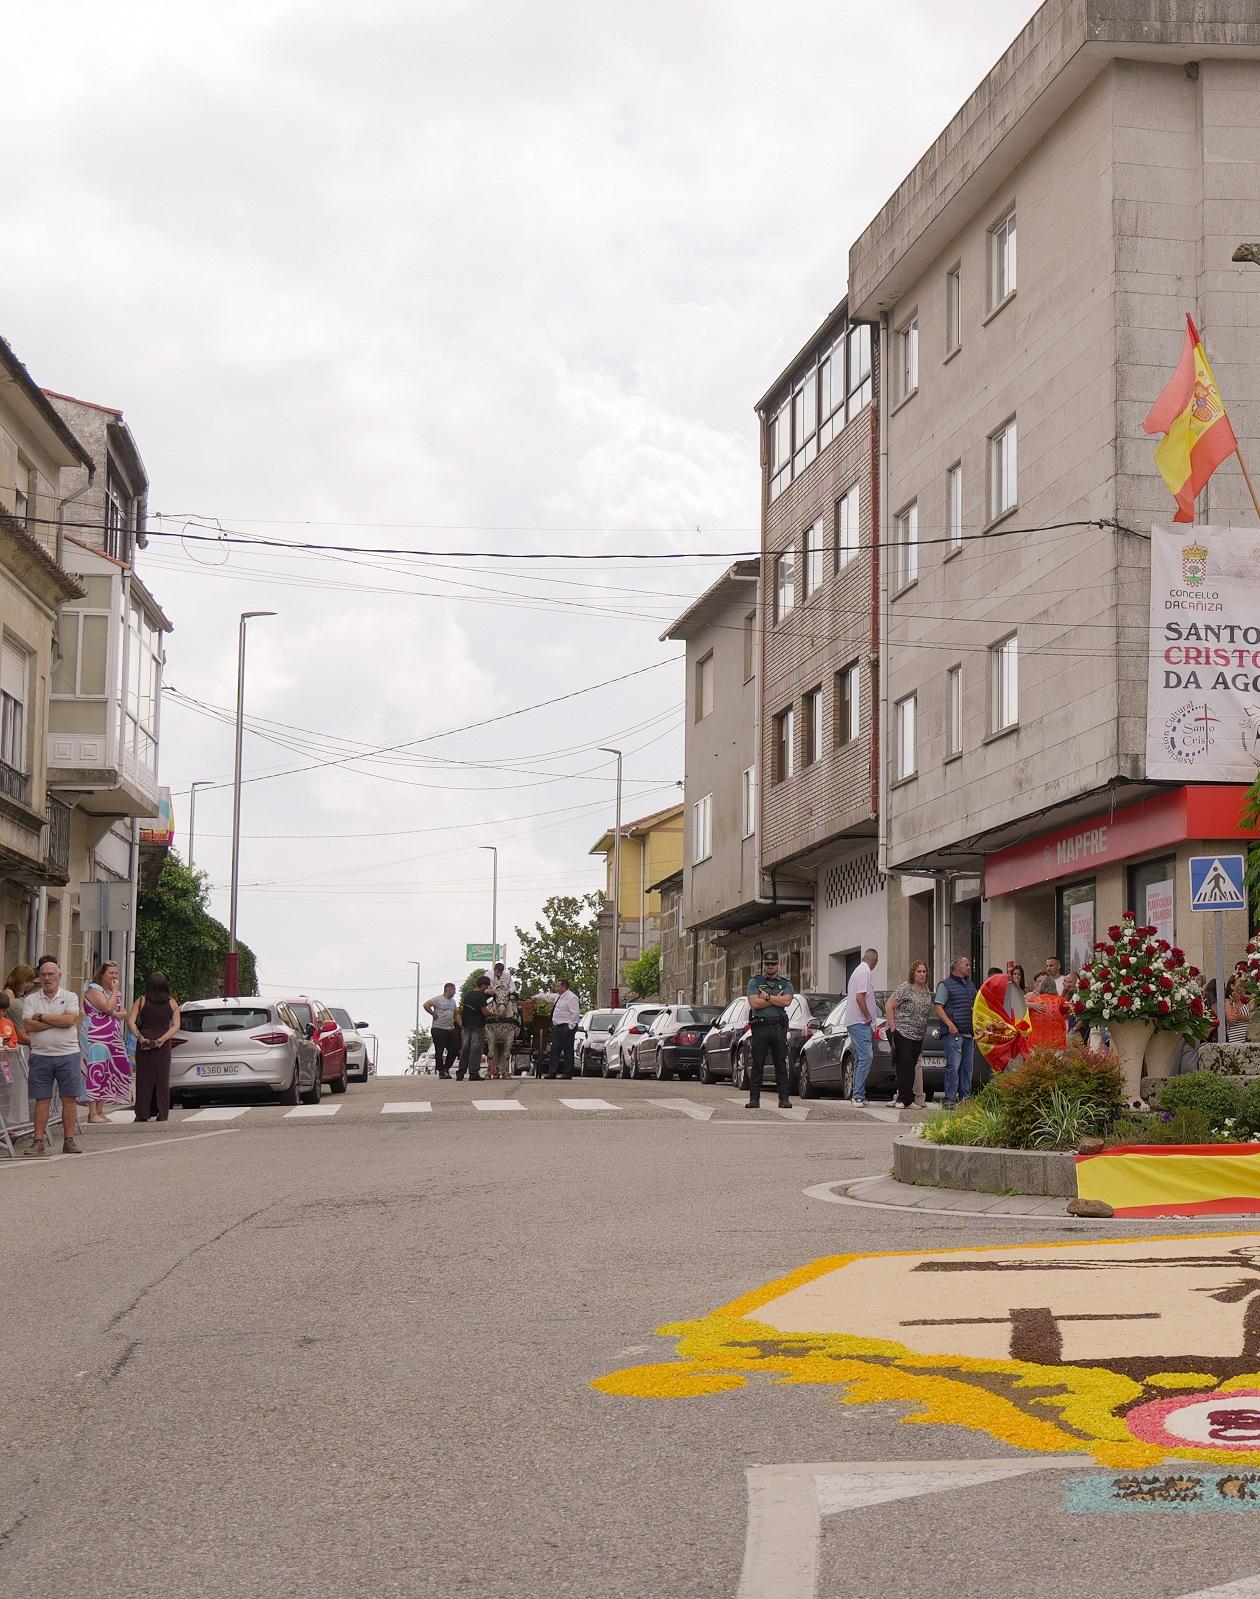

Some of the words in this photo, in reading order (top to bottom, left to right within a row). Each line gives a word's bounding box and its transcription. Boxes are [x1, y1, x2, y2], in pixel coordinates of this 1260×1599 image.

[1163, 670, 1202, 689] DA
[1057, 826, 1108, 864] MAPFRE
[201, 1066, 222, 1075] 5360
